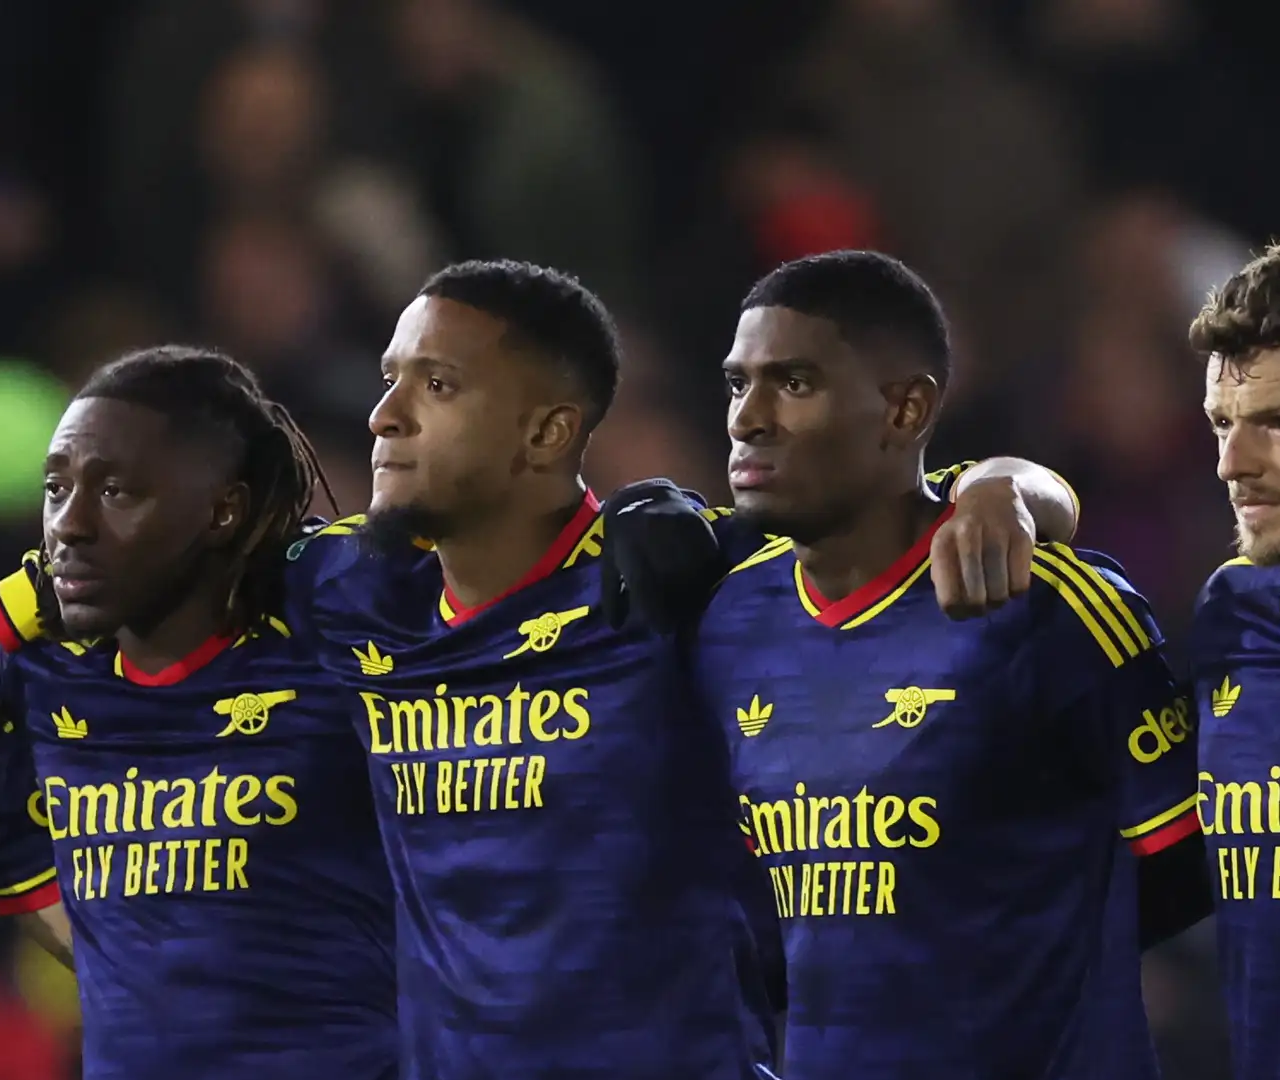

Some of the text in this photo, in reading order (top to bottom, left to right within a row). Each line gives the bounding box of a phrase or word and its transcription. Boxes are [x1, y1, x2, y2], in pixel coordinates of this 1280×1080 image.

[361, 683, 591, 753] Emirates
[44, 767, 298, 842] Emirates
[392, 755, 547, 815] FLY BETTER
[72, 836, 250, 899] FLY BETTER
[800, 860, 897, 916] BETTER
[1217, 847, 1262, 899] FLY
